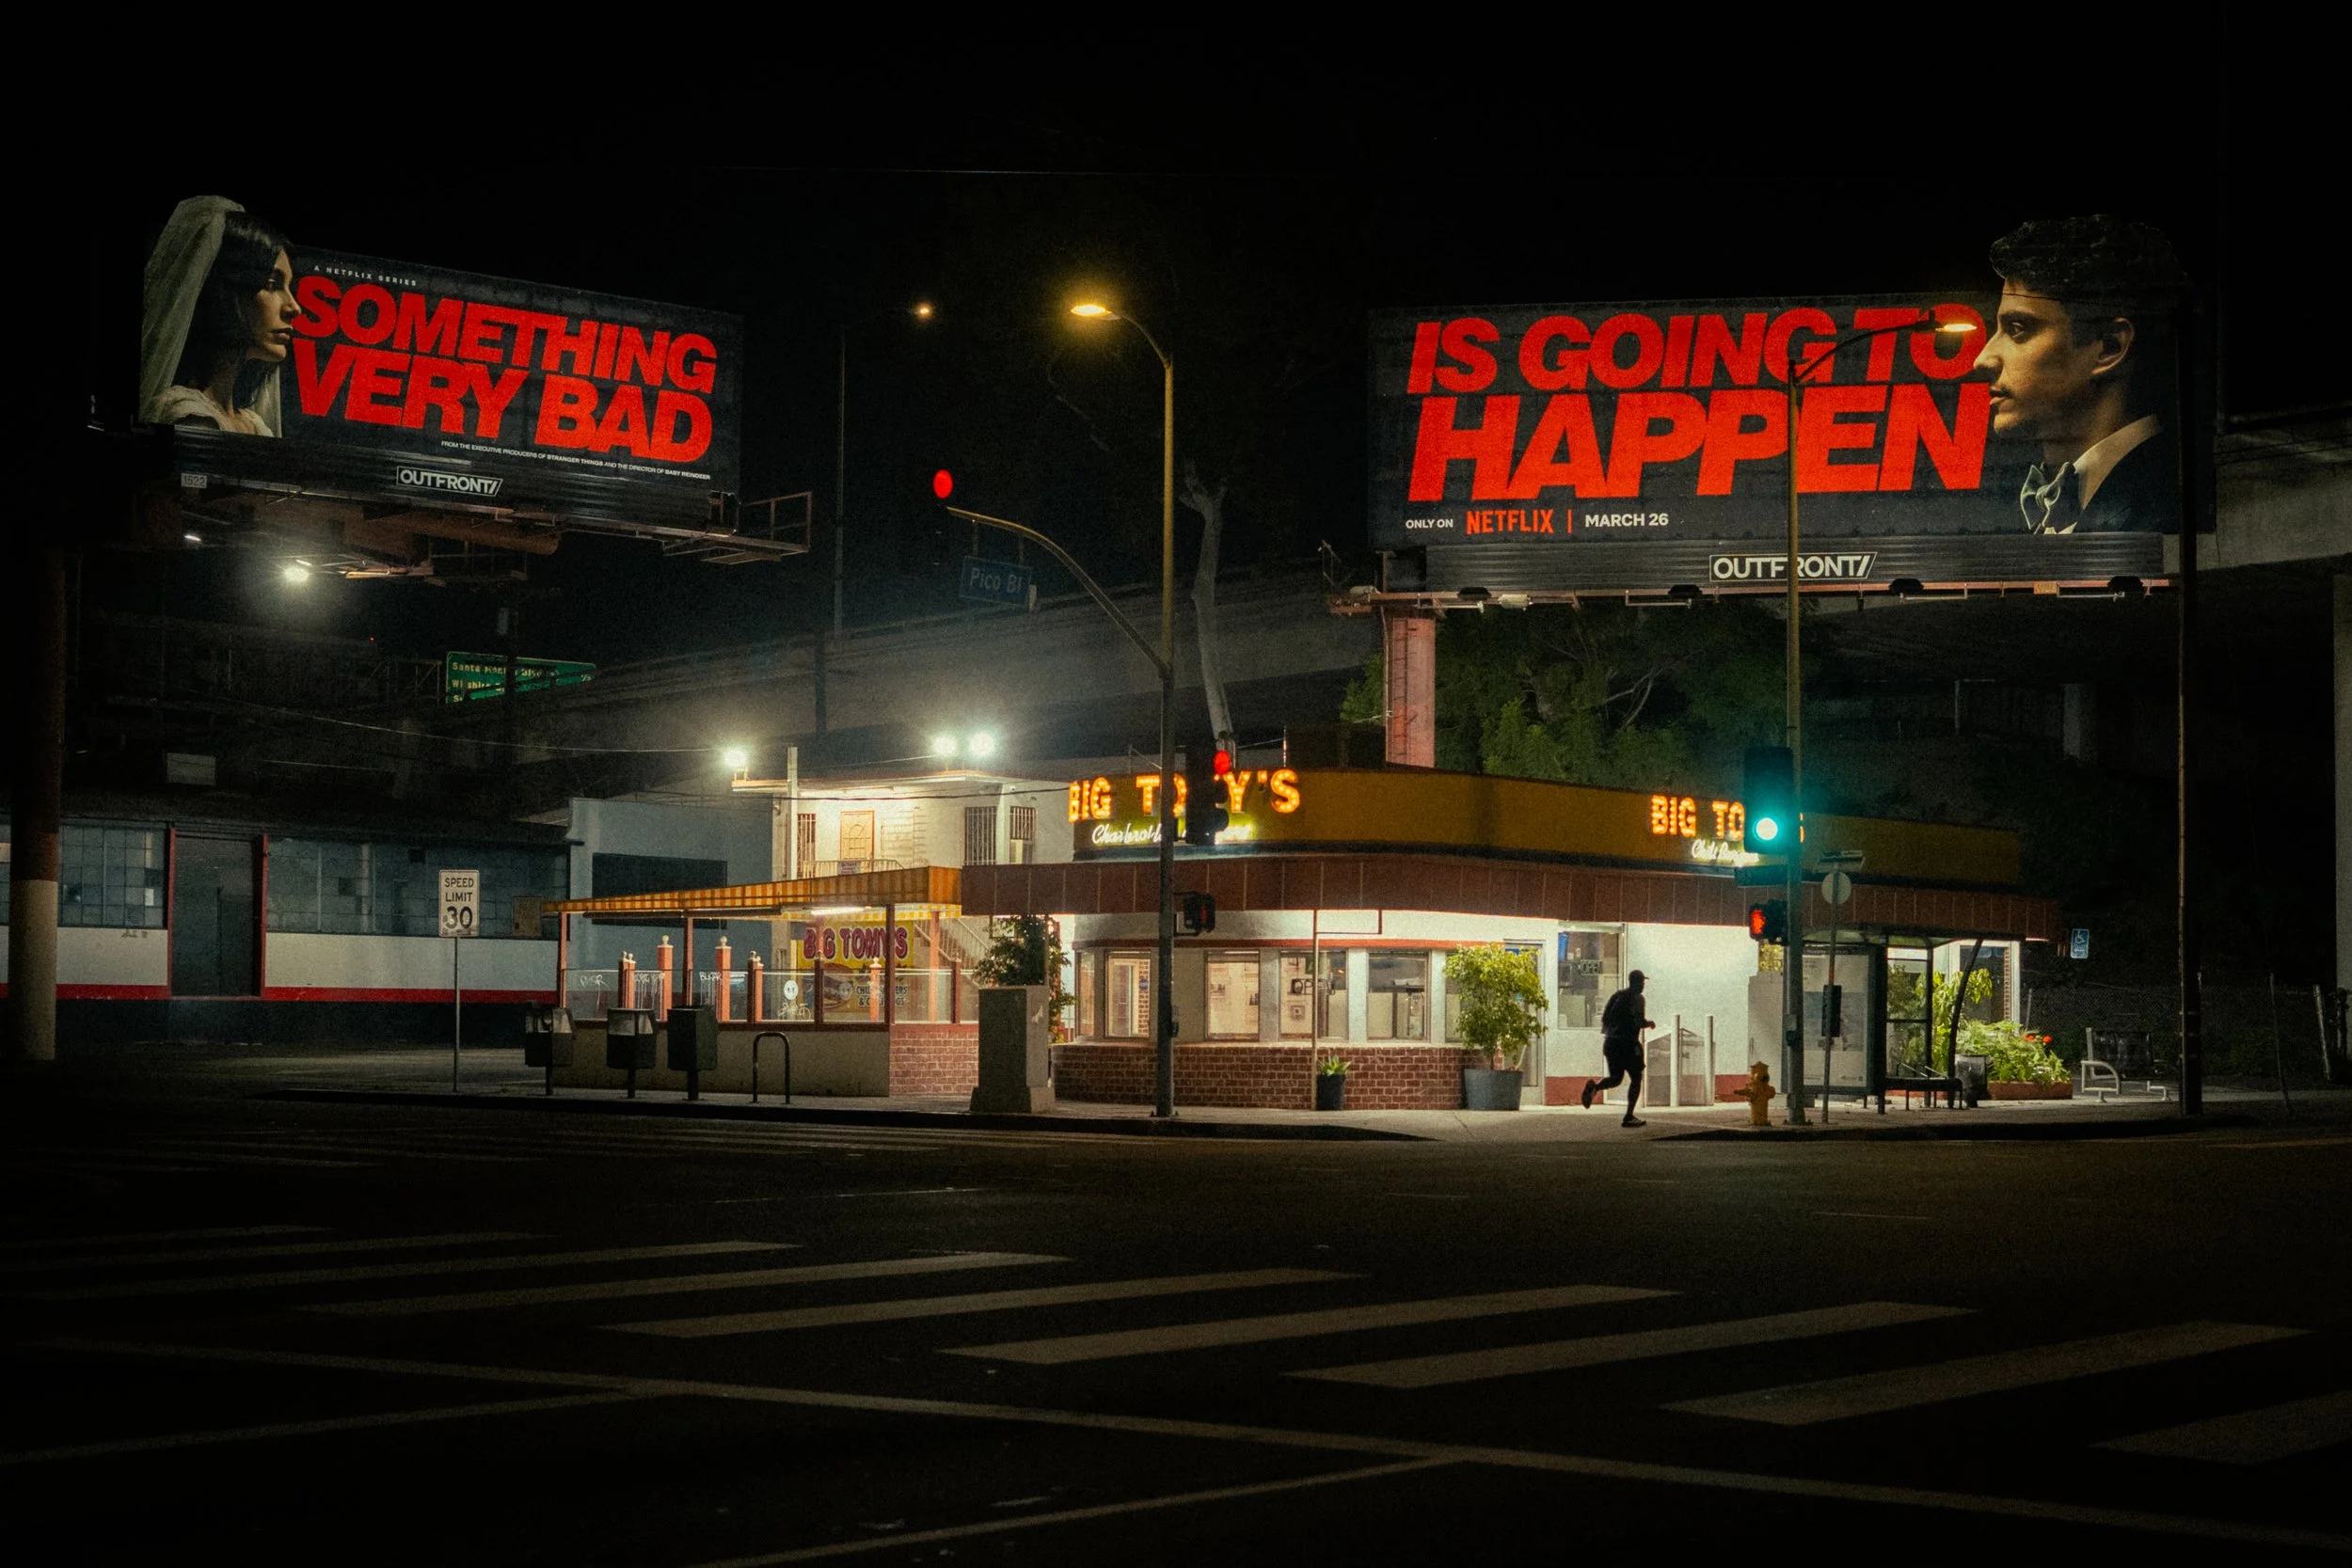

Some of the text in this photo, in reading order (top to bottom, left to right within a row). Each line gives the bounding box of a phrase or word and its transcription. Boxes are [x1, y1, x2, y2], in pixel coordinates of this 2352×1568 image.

[326, 267, 373, 279] NETFLIX
[378, 275, 417, 287] SERIES
[290, 275, 718, 394] SOMETHING
[1407, 303, 1988, 393] IS GOING TO
[293, 338, 713, 464] VERY BAD
[1408, 382, 1991, 501] HAPPEN
[441, 440, 458, 449] FROM
[471, 444, 502, 454] EXECUTIVE
[502, 449, 537, 459] PRODUCERS
[547, 454, 580, 464] STRANGER
[580, 458, 603, 467] THINGS
[628, 465, 657, 474] DIRECTOR
[681, 471, 710, 481] REINDEER
[183, 474, 206, 487] 1522
[1406, 509, 1669, 535] ONLY ON NETFLIX MARCH 26
[969, 567, 1002, 591] Pico
[1068, 768, 1301, 823] BIG TOY'S
[1651, 795, 1696, 838] BIG
[445, 878, 474, 888] SPEED
[445, 892, 473, 902] LIMIT
[445, 906, 473, 929] 30
[803, 927, 836, 959] BG
